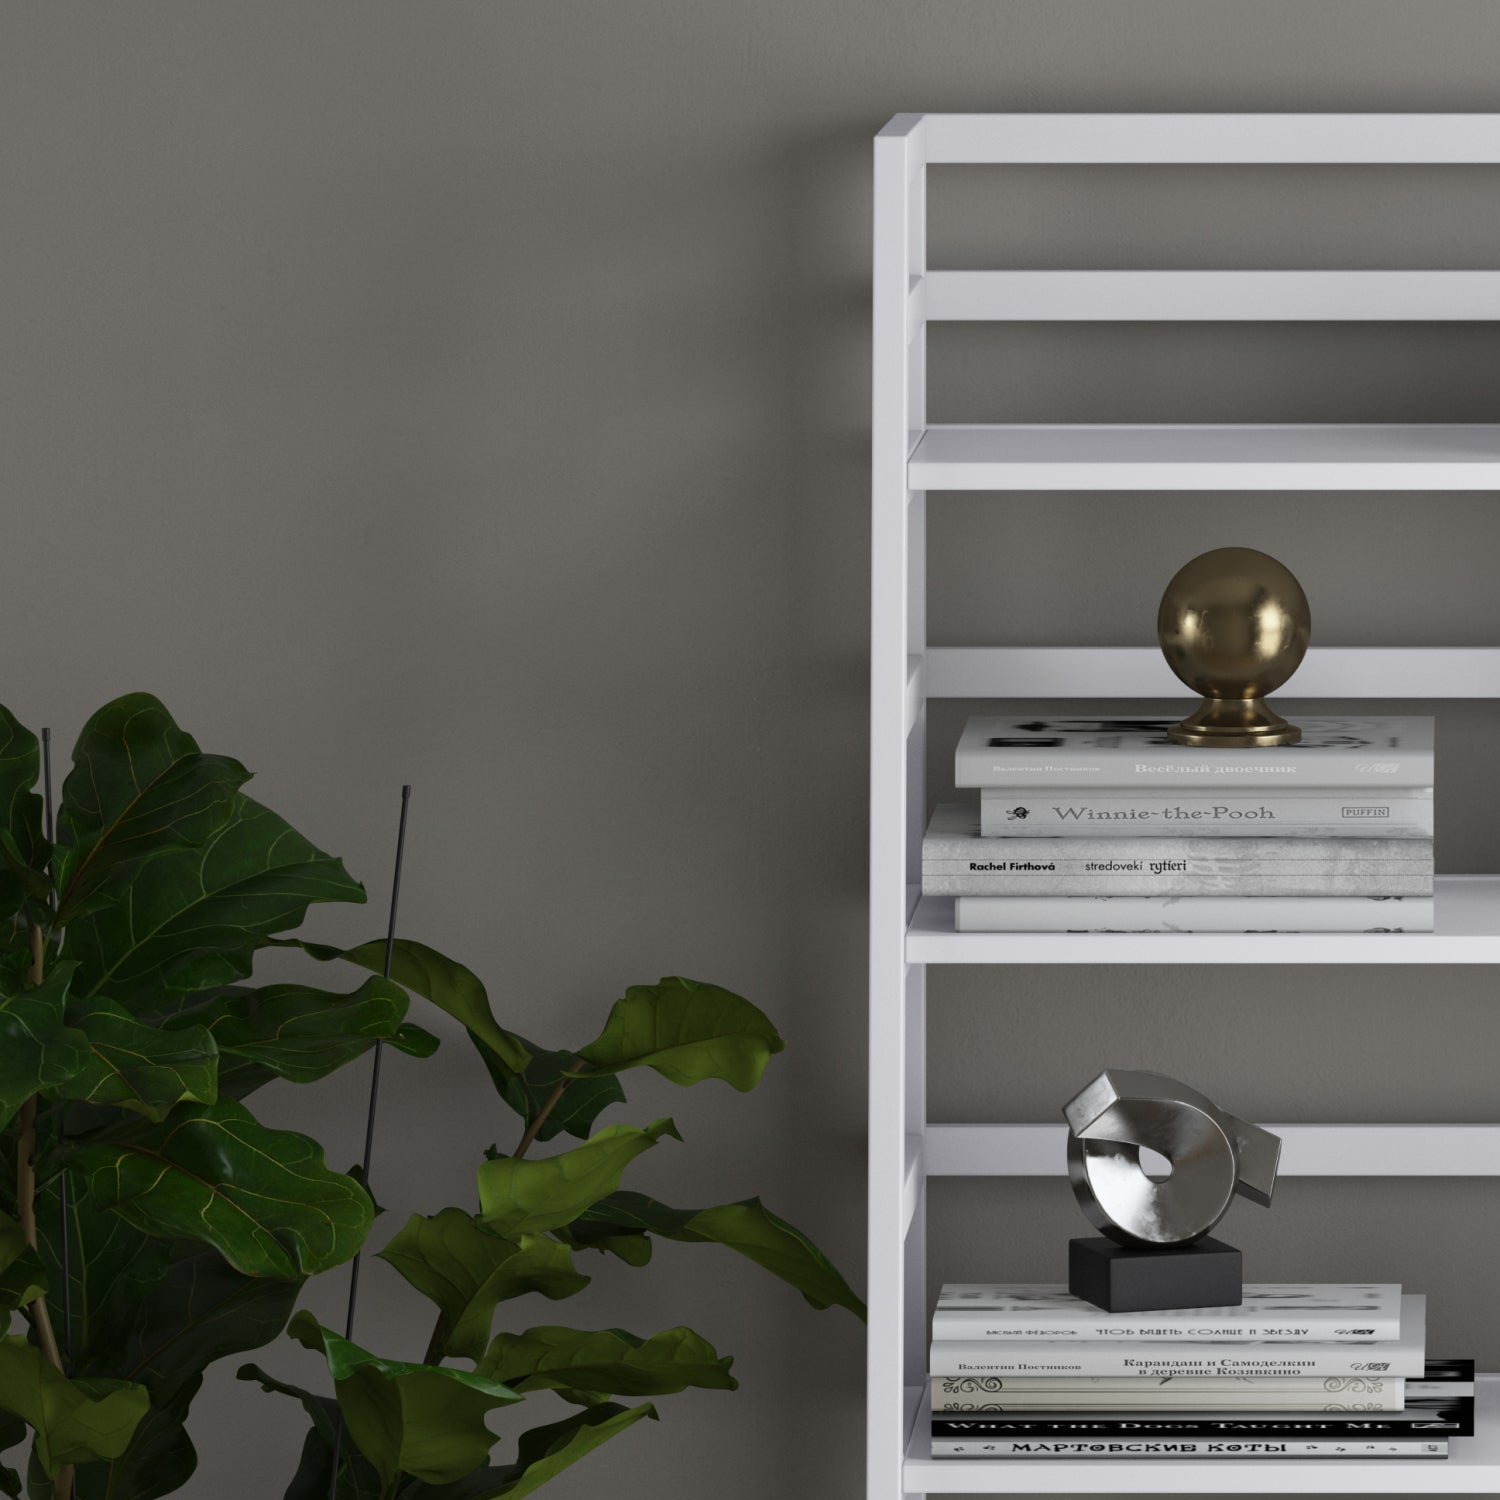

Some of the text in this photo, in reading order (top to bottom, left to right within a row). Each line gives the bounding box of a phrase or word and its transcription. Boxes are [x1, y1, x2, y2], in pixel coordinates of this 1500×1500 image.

[1135, 763, 1297, 775] Весёлый двоечник
[1052, 806, 1276, 820] Winnie-the-Pooh
[1345, 808, 1386, 817] PUFFIN
[969, 861, 1056, 871] Rachel Firthová
[1085, 860, 1144, 871] stredovekí
[1123, 1358, 1202, 1368] Карандаш
[1220, 1358, 1316, 1368] Самоделкин
[1216, 1367, 1301, 1376] Козявкино
[1012, 1443, 1287, 1452] МАРТОВСКИЕ КОТЫ
